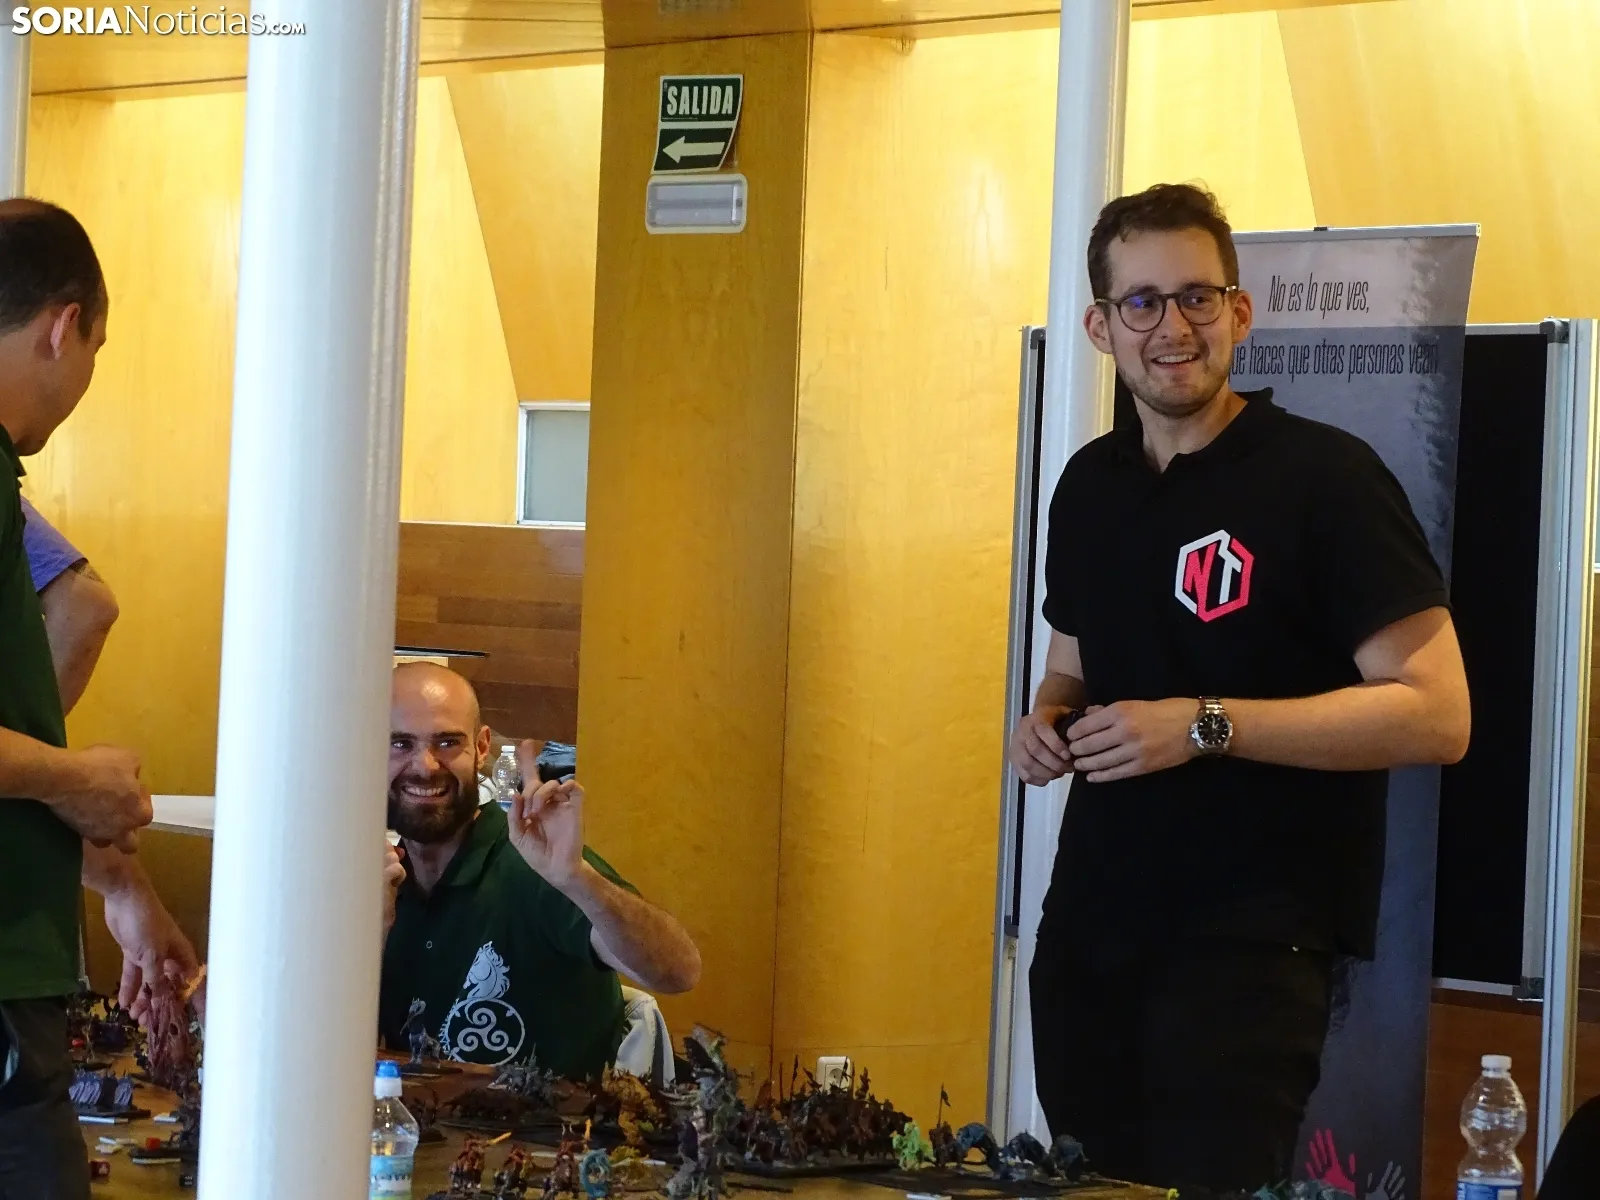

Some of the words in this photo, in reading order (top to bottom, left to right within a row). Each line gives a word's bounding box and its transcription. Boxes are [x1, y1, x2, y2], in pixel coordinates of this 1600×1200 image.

[666, 85, 734, 116] SALIDA
[1268, 275, 1286, 312] No
[1287, 281, 1304, 312] es
[1305, 272, 1319, 312] lo
[1319, 281, 1343, 319] que
[1346, 281, 1369, 313] ves,
[1249, 336, 1284, 375] haces
[1288, 344, 1310, 383] que
[1313, 338, 1344, 375] otras
[1348, 344, 1404, 383] personas
[1409, 343, 1438, 375] vean
